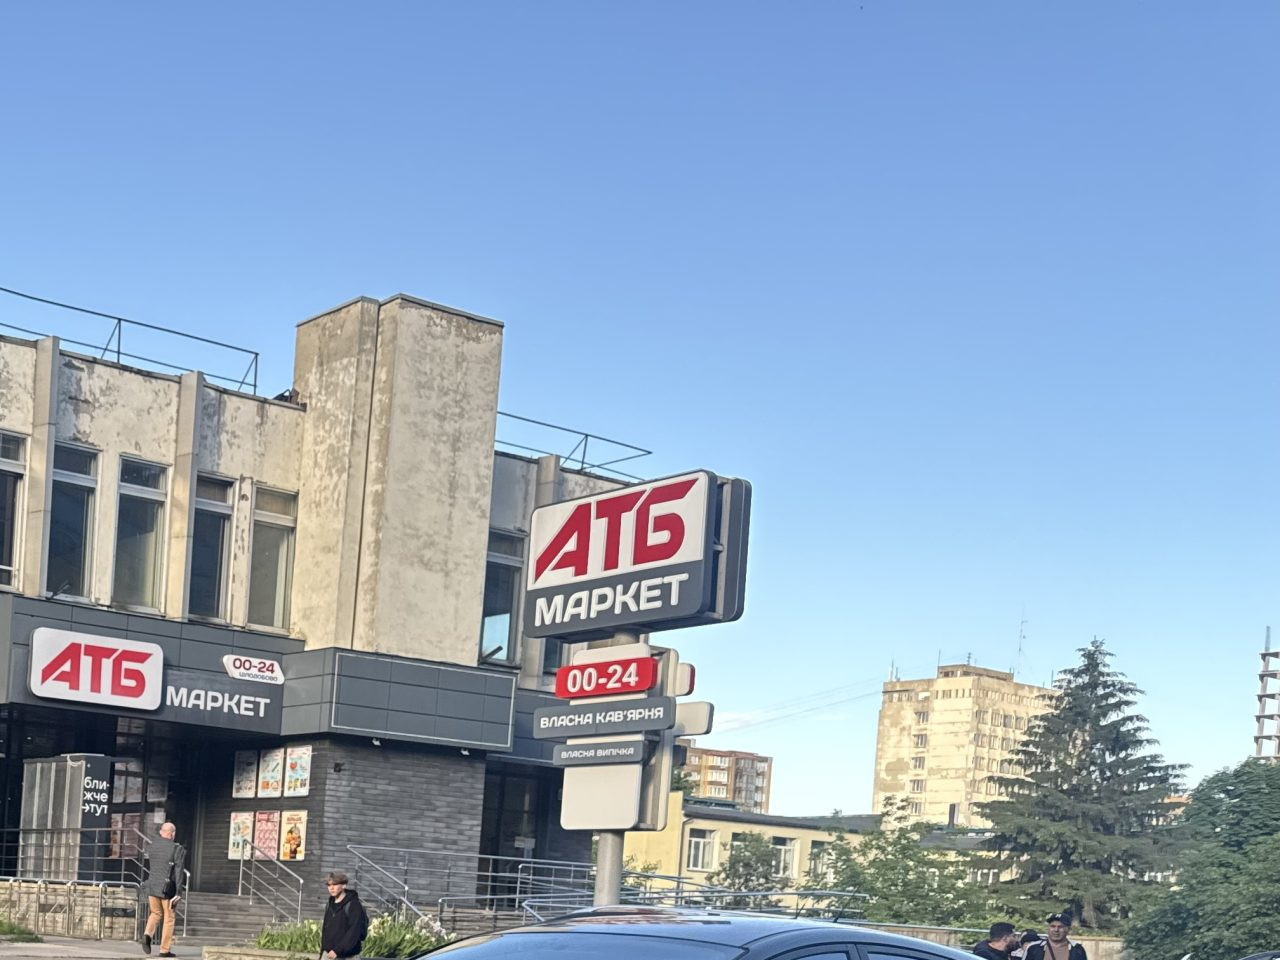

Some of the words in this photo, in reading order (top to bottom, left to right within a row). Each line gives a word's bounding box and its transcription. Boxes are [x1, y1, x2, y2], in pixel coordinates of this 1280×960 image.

[534, 477, 700, 585] АТБ
[534, 573, 689, 627] МАРКЕТ
[41, 642, 153, 698] АТБ
[233, 657, 275, 675] 00-24
[567, 662, 639, 693] 00-24
[165, 685, 271, 718] МАРКЕТ
[540, 714, 593, 729] ВЛАСНА
[596, 707, 664, 724] КАВ'ЯРНЯ
[561, 749, 595, 759] ВЛАСНА
[596, 747, 635, 757] ВИПІЧКА
[83, 792, 109, 802] жче
[90, 803, 108, 816] тут
